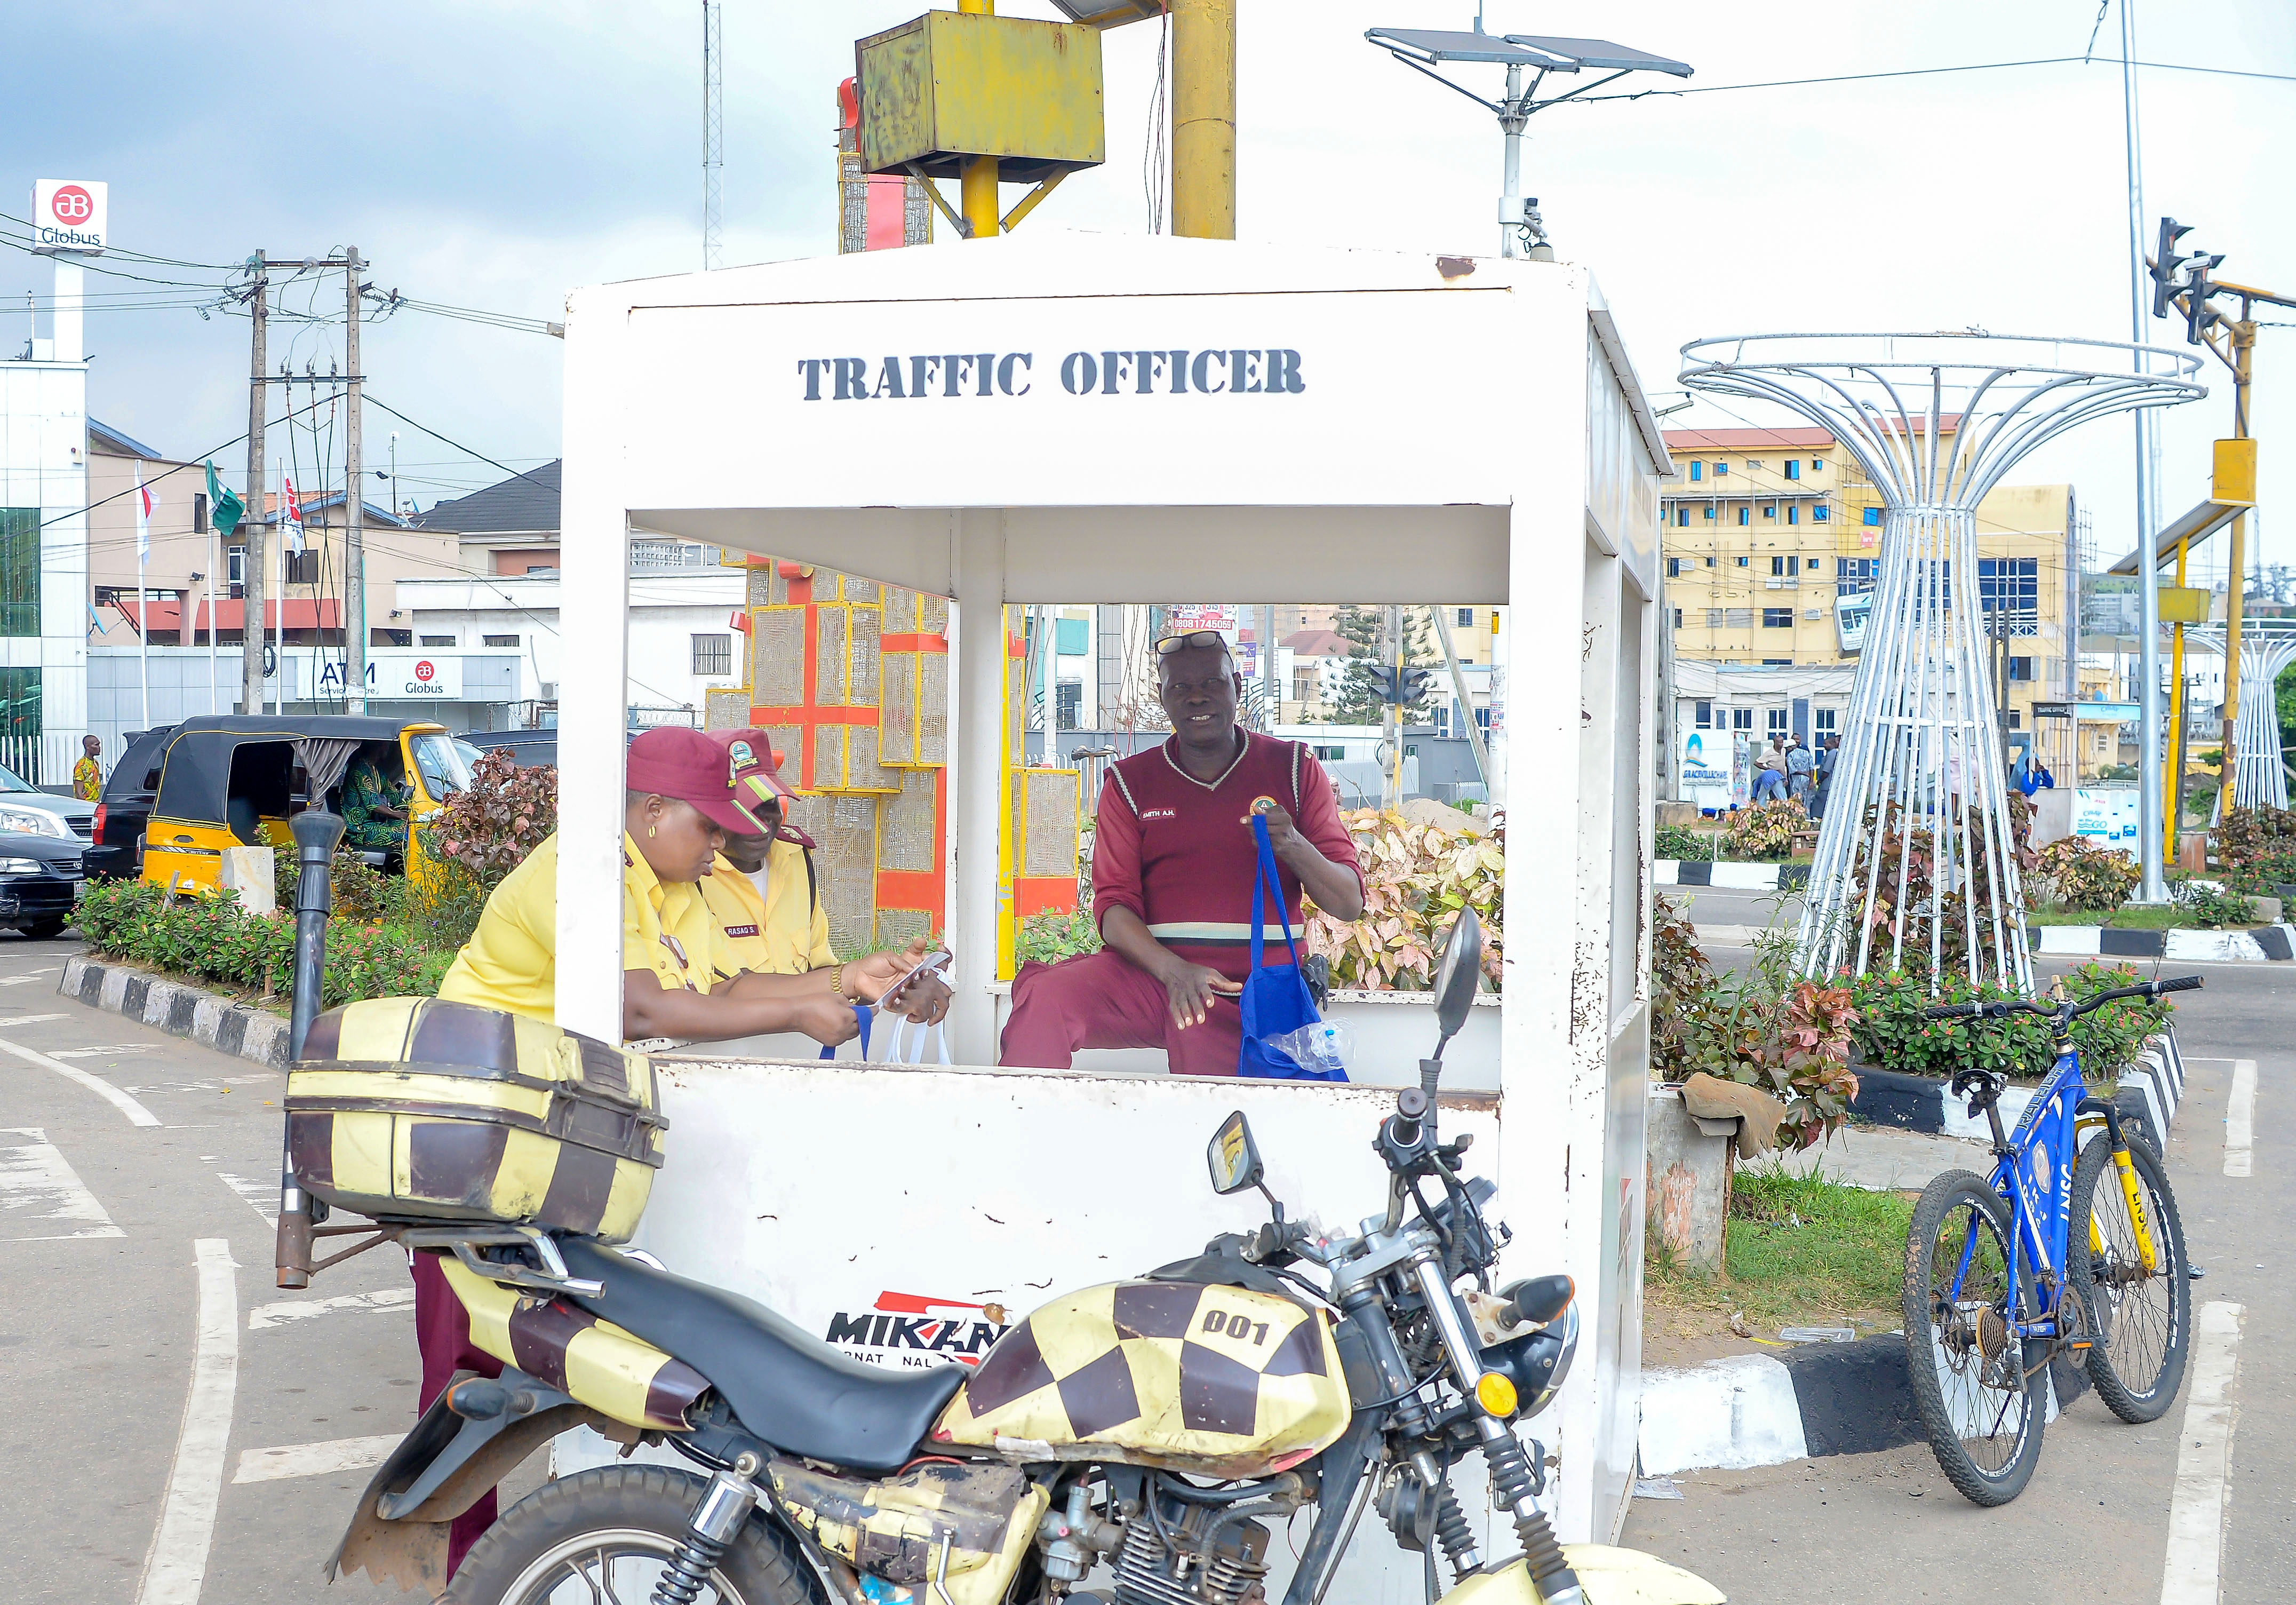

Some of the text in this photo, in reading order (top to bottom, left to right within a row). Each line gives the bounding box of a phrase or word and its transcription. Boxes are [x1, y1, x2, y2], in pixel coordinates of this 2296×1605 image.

[42, 227, 100, 245] Globus
[798, 349, 1306, 401] TRAFFIC OFFICER
[1174, 619, 1231, 629] 08081745059
[405, 682, 443, 694] Globus
[728, 927, 748, 935] RASAQ
[2016, 1068, 2065, 1131] RALEIGH
[826, 1312, 1015, 1354] MIKAN
[1201, 1310, 1270, 1346] 001
